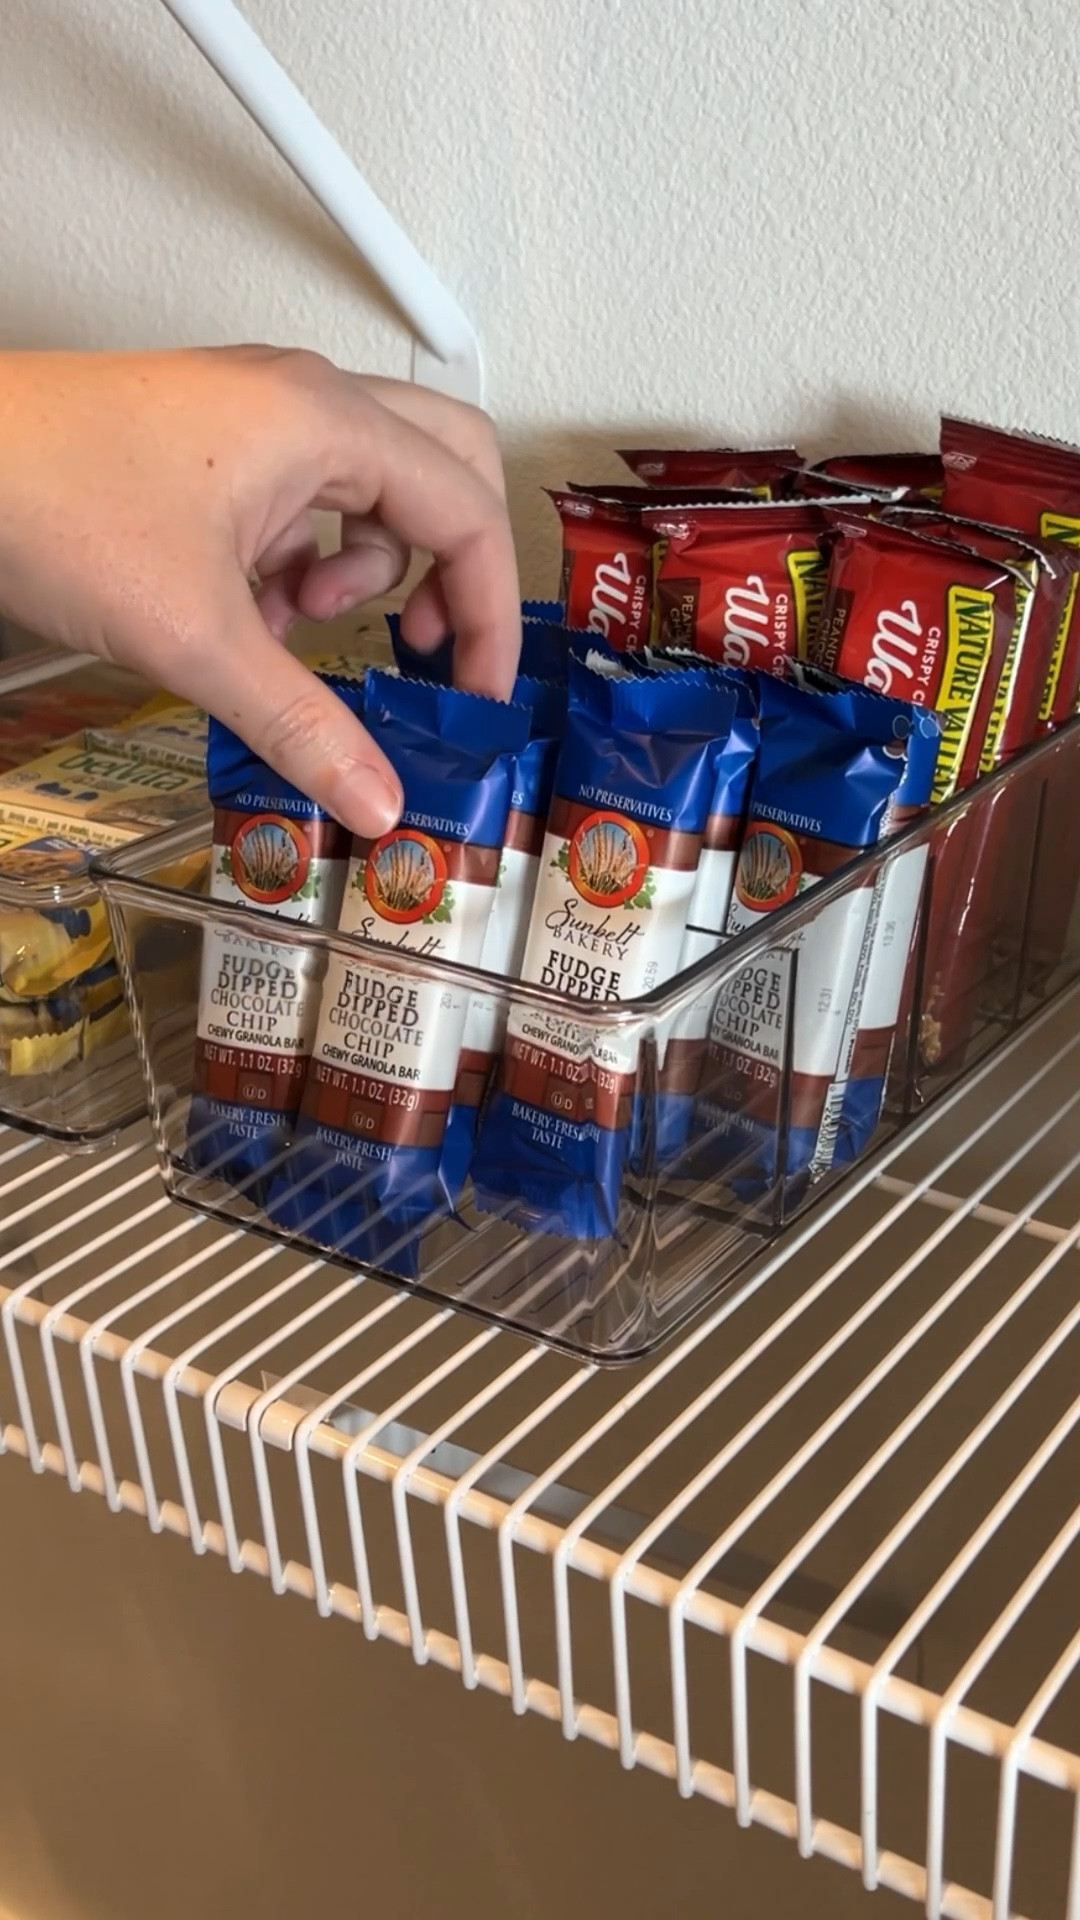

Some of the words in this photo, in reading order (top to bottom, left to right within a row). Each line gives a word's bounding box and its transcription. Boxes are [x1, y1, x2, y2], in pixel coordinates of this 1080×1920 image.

[629, 574, 647, 630] CRISPY
[773, 593, 789, 650] CRISPY
[823, 607, 847, 671] PEANUT
[918, 626, 941, 687] CRISPY
[950, 594, 993, 701] NATURE
[234, 793, 252, 805] NO
[578, 784, 595, 799] NO
[595, 787, 673, 823] PRESERVATIVES
[545, 898, 645, 947] Sunbelt
[552, 923, 630, 962] BAKERY
[221, 953, 296, 980] FUDGE
[547, 949, 622, 992] FUDGE
[210, 988, 305, 1018] CHOCOLATE
[217, 970, 299, 1000] DIPPED
[342, 969, 420, 1009] FUDGE
[226, 1010, 278, 1033] CHIP
[328, 1006, 425, 1047] CHOCOLATE
[337, 991, 420, 1028] DIPPED
[715, 1008, 760, 1038] CHIP
[207, 1023, 235, 1041] CHEWY
[235, 1029, 282, 1049] GRANOLA
[284, 1036, 305, 1049] BAR
[343, 1031, 395, 1060] CHIP
[521, 1023, 551, 1043] CHEWY
[204, 1043, 217, 1061] NET
[217, 1048, 237, 1067] WT.
[240, 1051, 253, 1069] 1.1
[257, 1054, 275, 1073] OZ.
[322, 1042, 351, 1064] CHEWY
[350, 1052, 397, 1077] GRANOLA
[398, 1064, 421, 1081] BAR
[512, 1041, 531, 1061] NET
[531, 1045, 548, 1070] WT.
[550, 1056, 564, 1077] 1.1
[316, 1064, 331, 1084] NET
[331, 1070, 348, 1091] WT.
[352, 1076, 367, 1096] 1.1
[368, 1081, 386, 1102] OZ.
[388, 1087, 420, 1112] (32g)
[210, 1101, 287, 1128] BAKERY-FRESH
[228, 1119, 260, 1140] TASTE
[315, 1126, 395, 1163] BAKERY-FRESH
[531, 1126, 564, 1150] TASTE
[335, 1150, 364, 1172] TASTE
